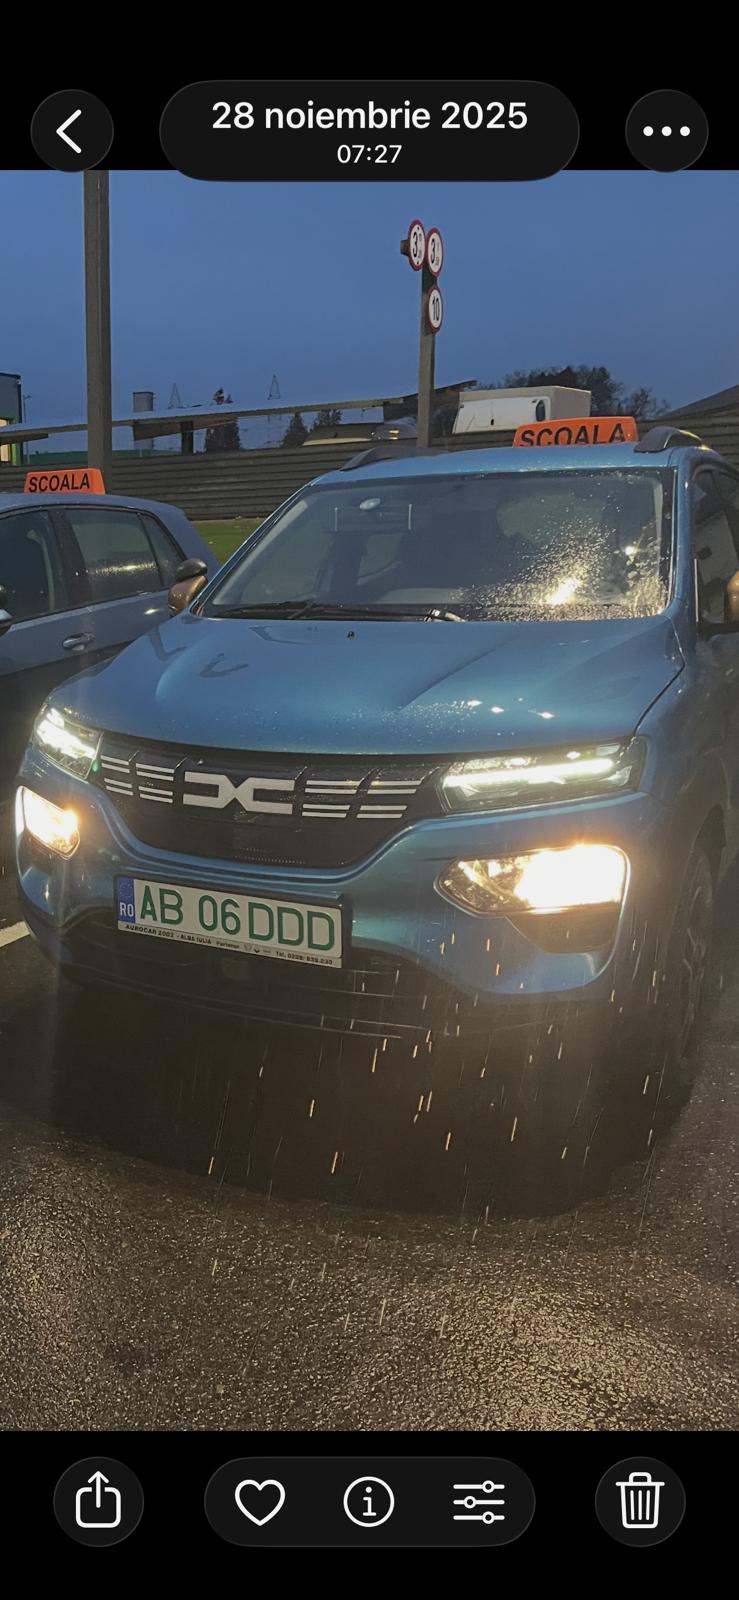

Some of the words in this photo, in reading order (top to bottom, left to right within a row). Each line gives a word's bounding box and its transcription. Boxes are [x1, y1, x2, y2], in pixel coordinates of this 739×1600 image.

[520, 422, 627, 447] SCOALA
[28, 473, 90, 493] SCOALA
[119, 902, 134, 917] RO
[140, 885, 184, 925] AB
[198, 894, 241, 936] 06
[248, 901, 335, 951] DDD
[125, 925, 157, 934] AUROCAR
